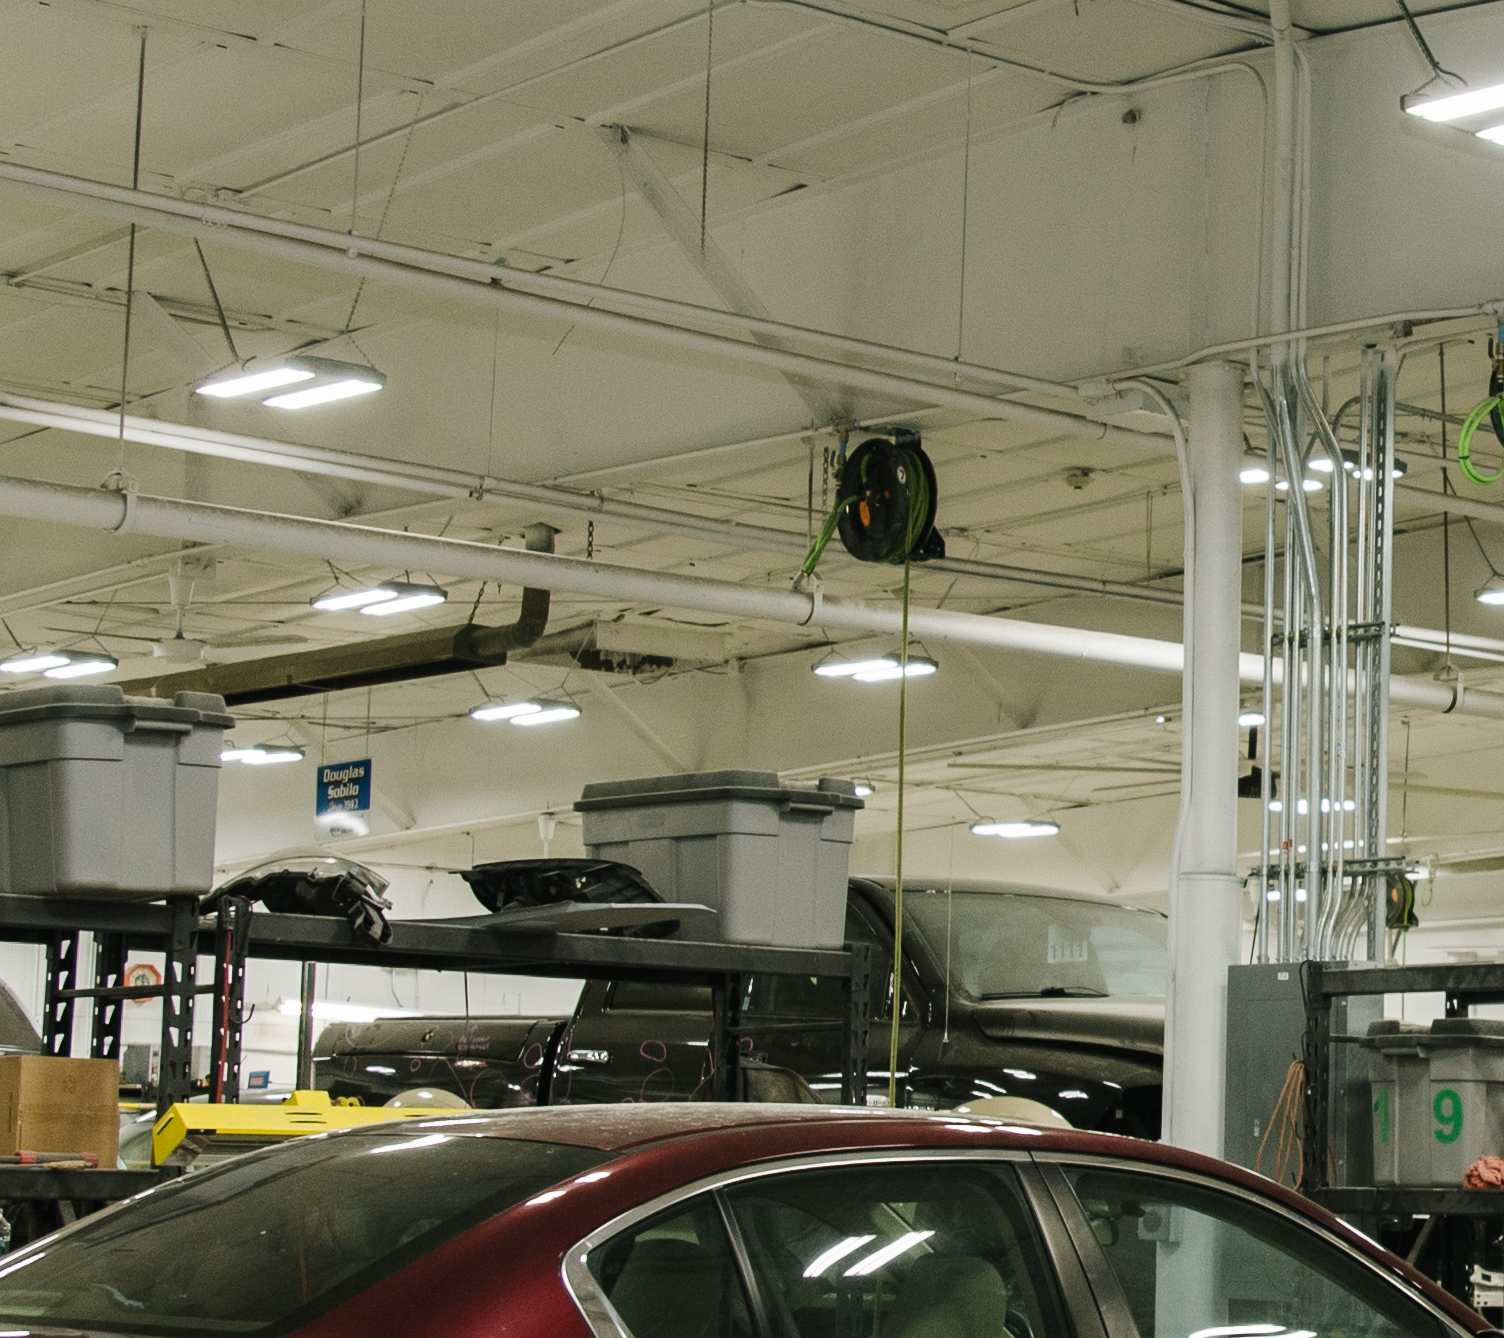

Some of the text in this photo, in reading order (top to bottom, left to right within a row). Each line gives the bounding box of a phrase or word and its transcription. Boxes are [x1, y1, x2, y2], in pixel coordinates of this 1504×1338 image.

[323, 766, 365, 783] Douglas
[328, 783, 359, 799] Sobilo
[1373, 1088, 1464, 1144] 1 9
